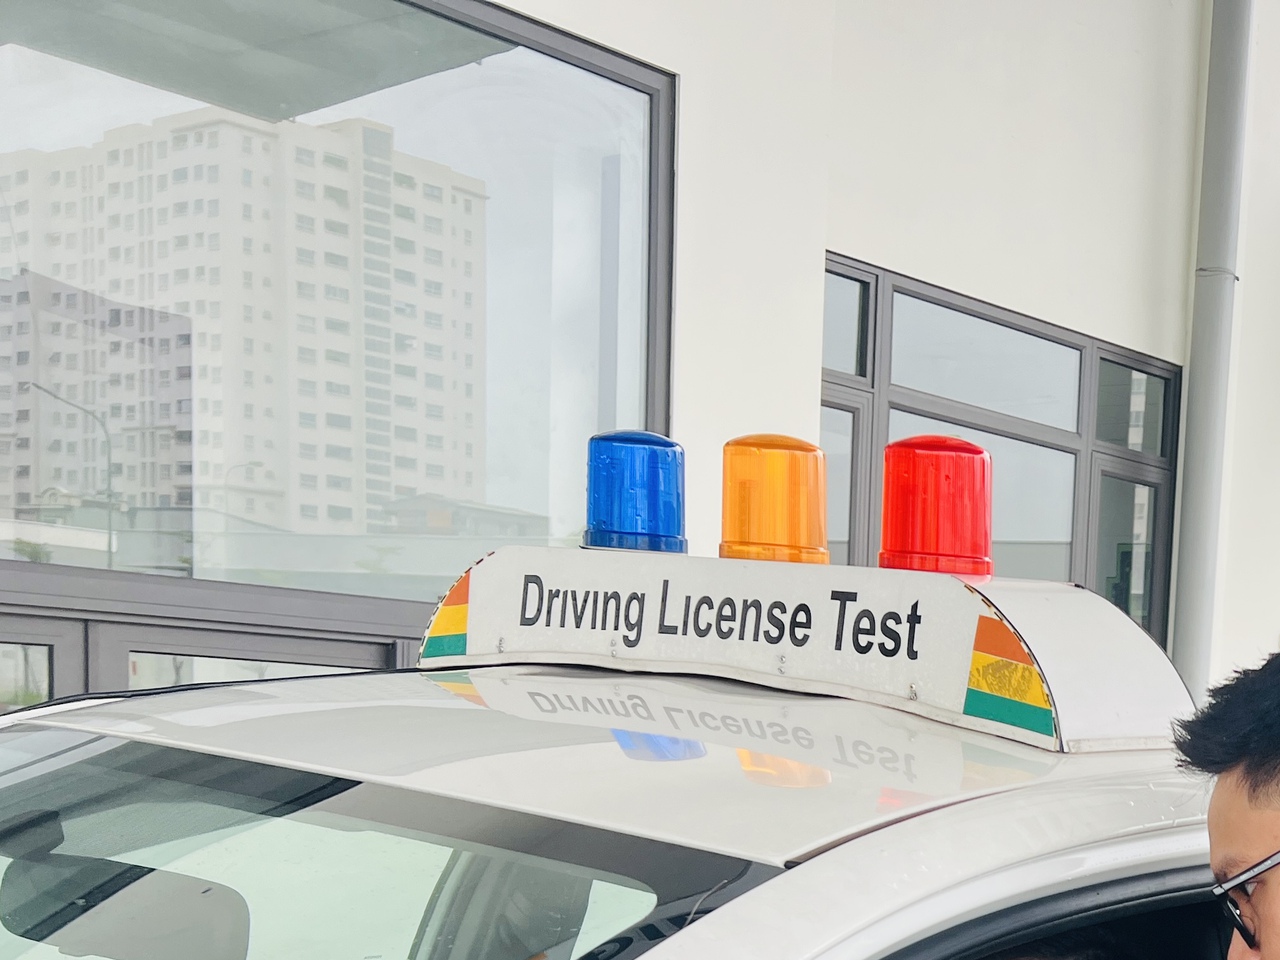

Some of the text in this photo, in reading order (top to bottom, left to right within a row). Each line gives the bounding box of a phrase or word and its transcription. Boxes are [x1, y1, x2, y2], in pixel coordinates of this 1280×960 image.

[519, 574, 922, 661] Driving License Test
